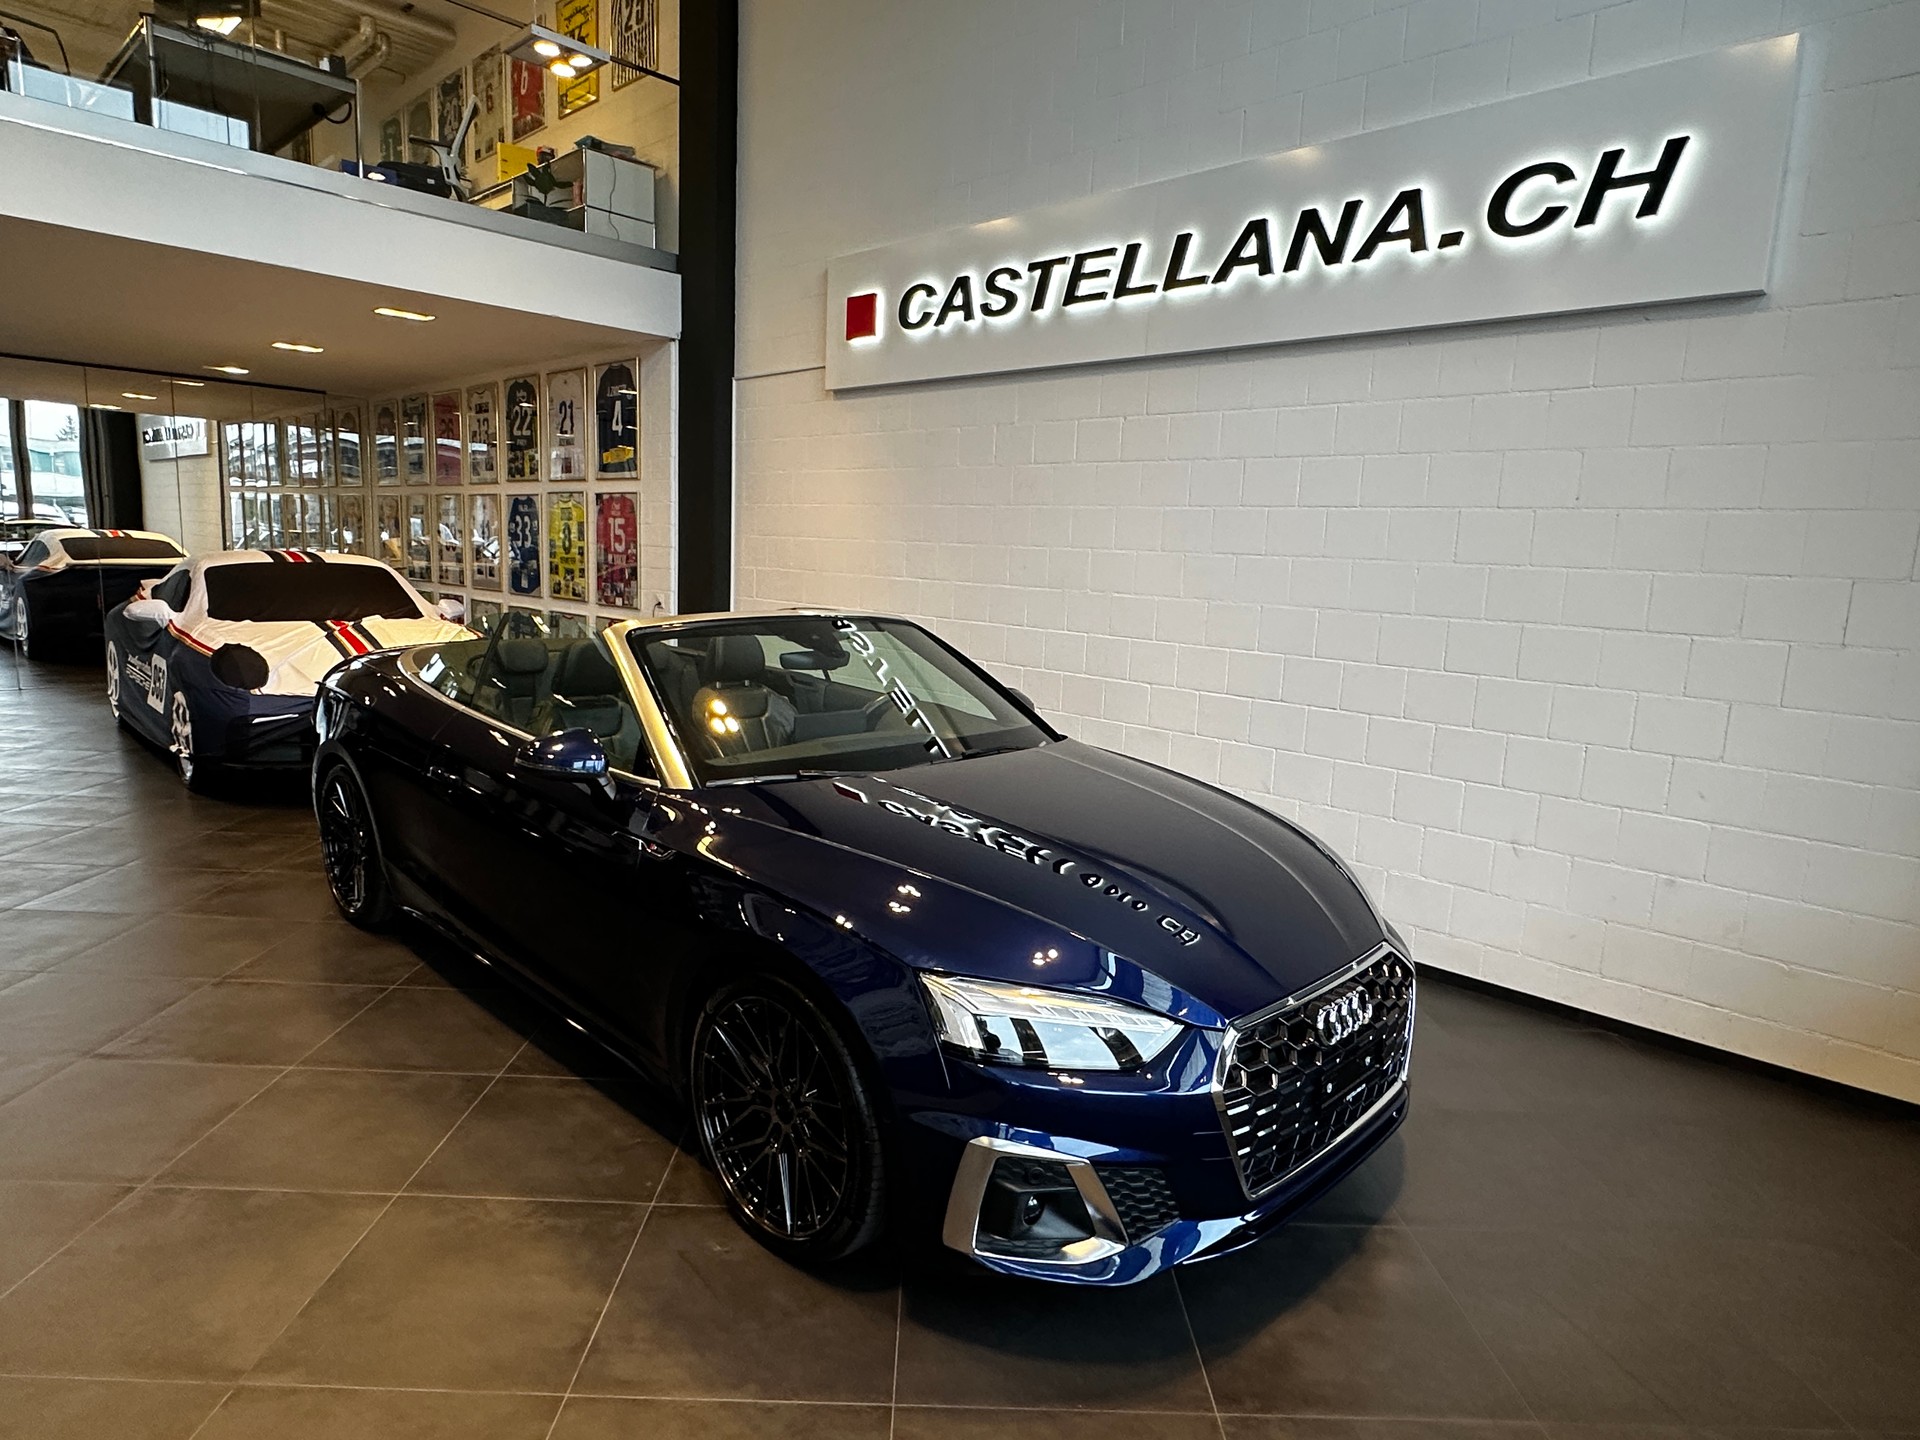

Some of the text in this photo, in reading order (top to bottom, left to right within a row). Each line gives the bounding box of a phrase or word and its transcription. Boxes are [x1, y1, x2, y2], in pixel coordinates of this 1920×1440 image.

[897, 135, 1690, 332] CASTELLANA.CH
[513, 406, 532, 436] 22
[559, 400, 575, 434] 21
[612, 400, 623, 436] 4
[514, 515, 532, 548] 33
[608, 517, 626, 553] 15
